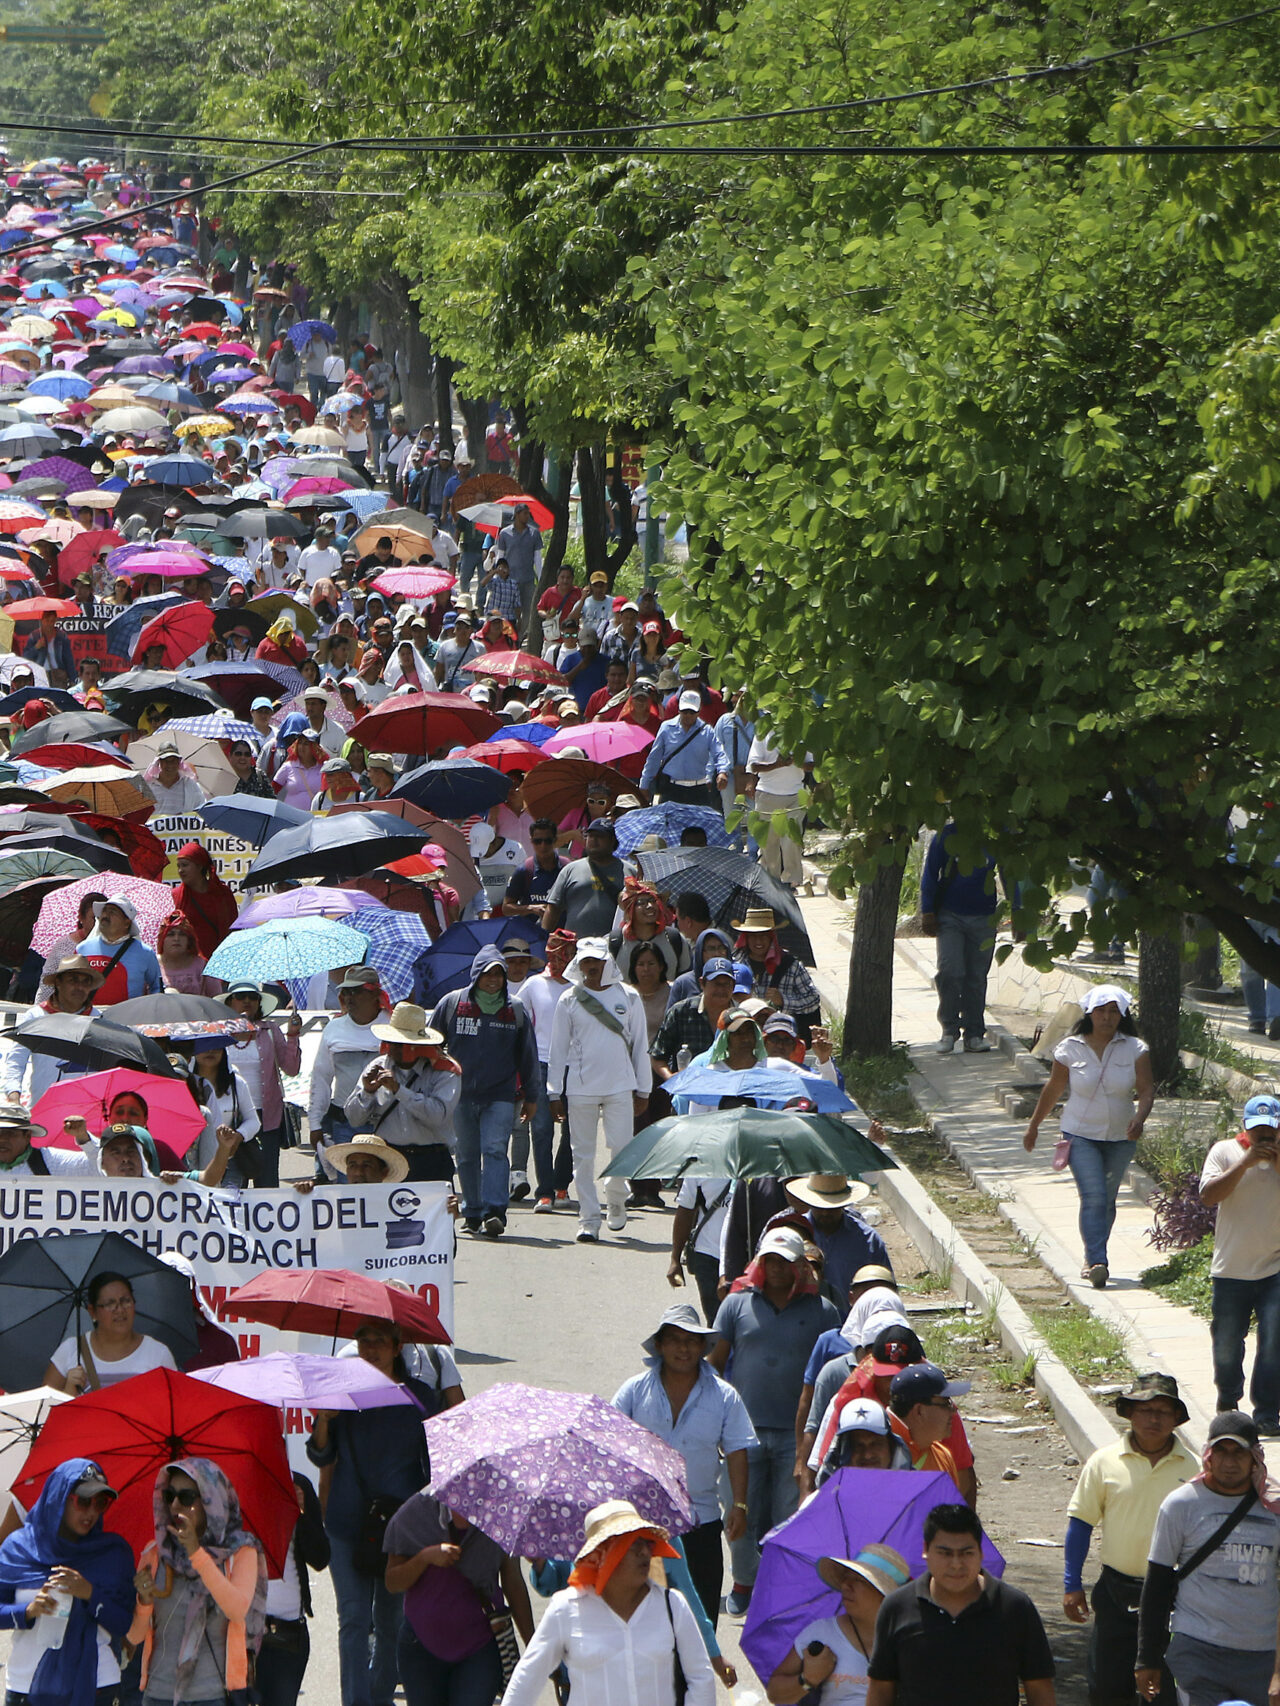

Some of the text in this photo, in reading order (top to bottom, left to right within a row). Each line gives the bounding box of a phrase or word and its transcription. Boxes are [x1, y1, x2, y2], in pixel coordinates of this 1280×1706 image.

[207, 836, 246, 852] INÉS
[56, 1189, 300, 1233] DEMOCRÁTICO
[312, 1198, 380, 1231] DEL
[364, 1253, 449, 1270] SUICOBACH
